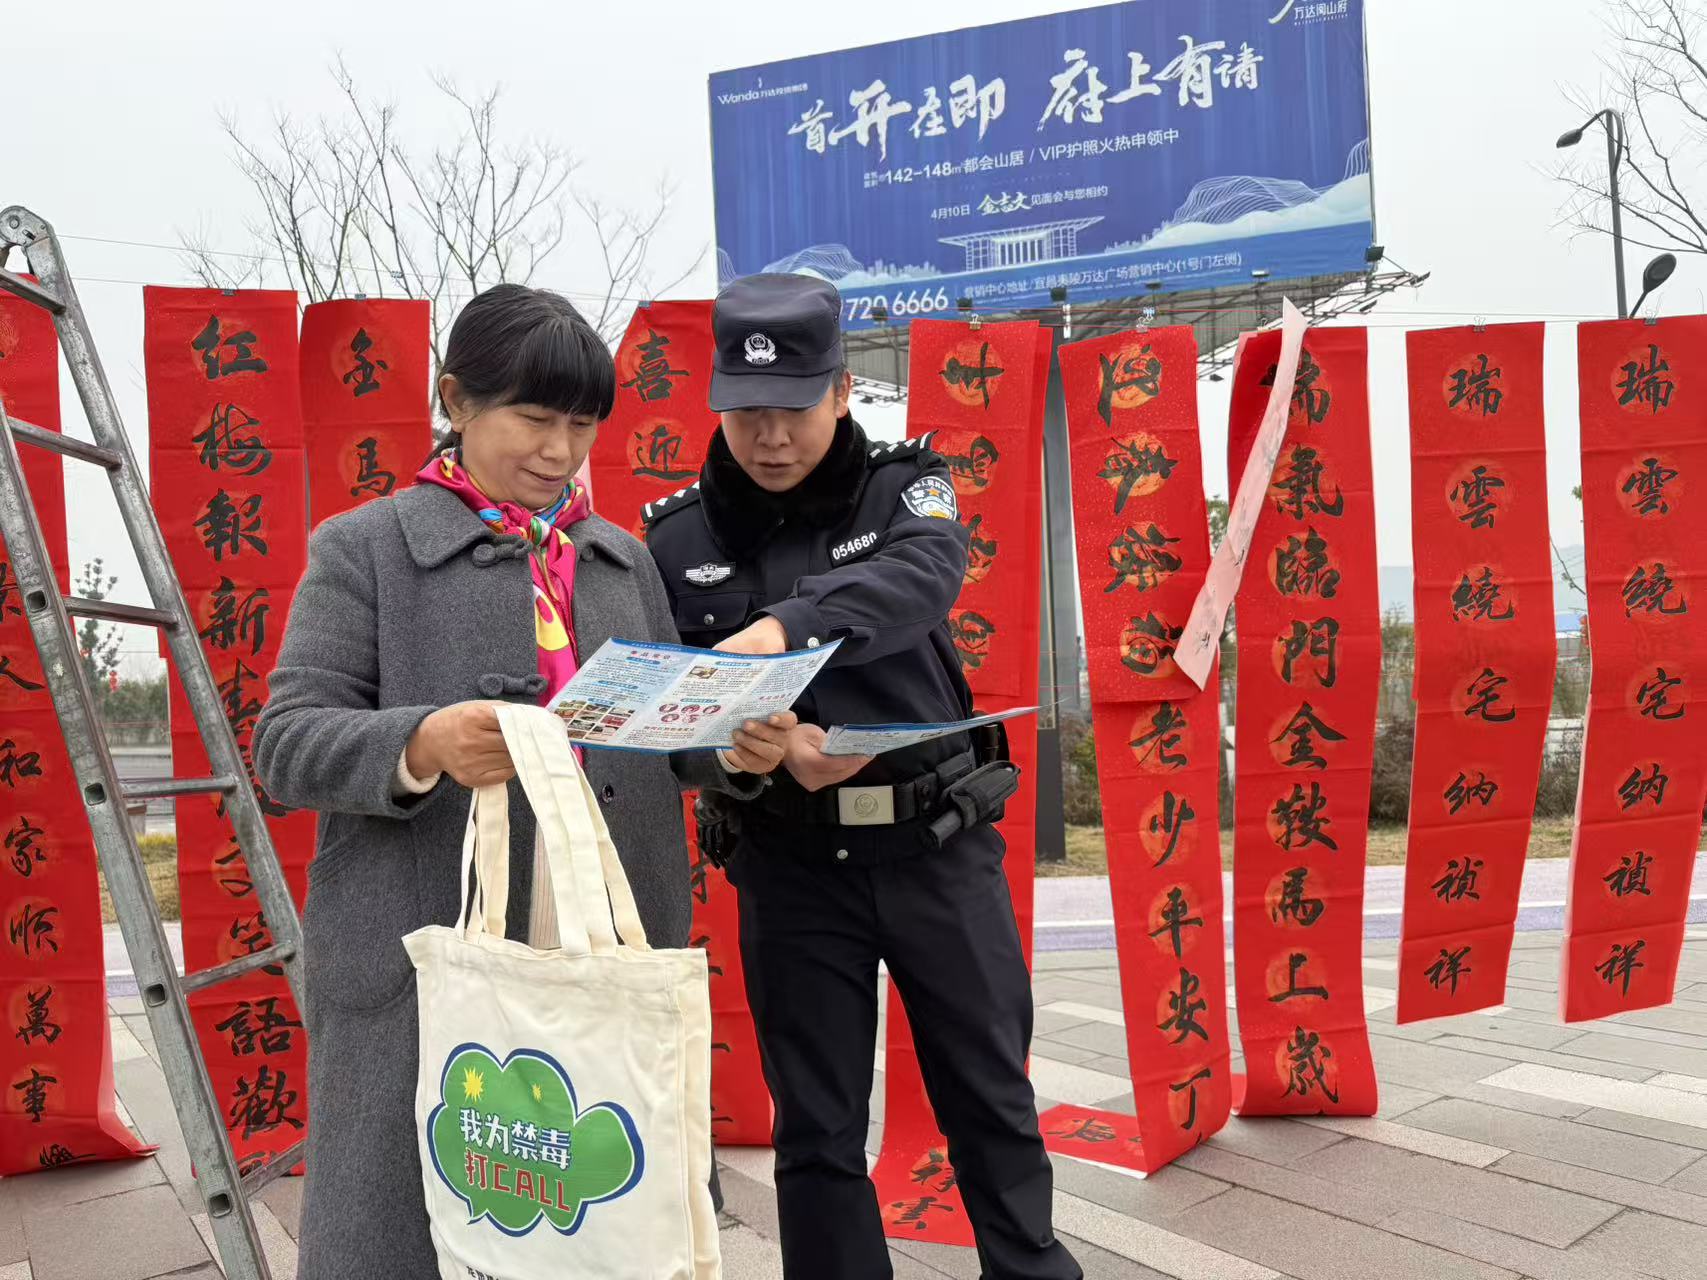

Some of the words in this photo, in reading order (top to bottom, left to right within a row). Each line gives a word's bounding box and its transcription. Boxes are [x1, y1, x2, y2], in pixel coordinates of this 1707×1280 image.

[717, 90, 759, 105] Wanda
[788, 75, 1006, 163] 首开在即
[1036, 34, 1264, 132] 府上有请
[1039, 128, 1179, 161] VIP护照火热申领中
[892, 286, 949, 316] 6666
[620, 328, 700, 481] 喜迎
[459, 1107, 571, 1171] 我为禁毒
[465, 1147, 571, 1212] 打CALL
